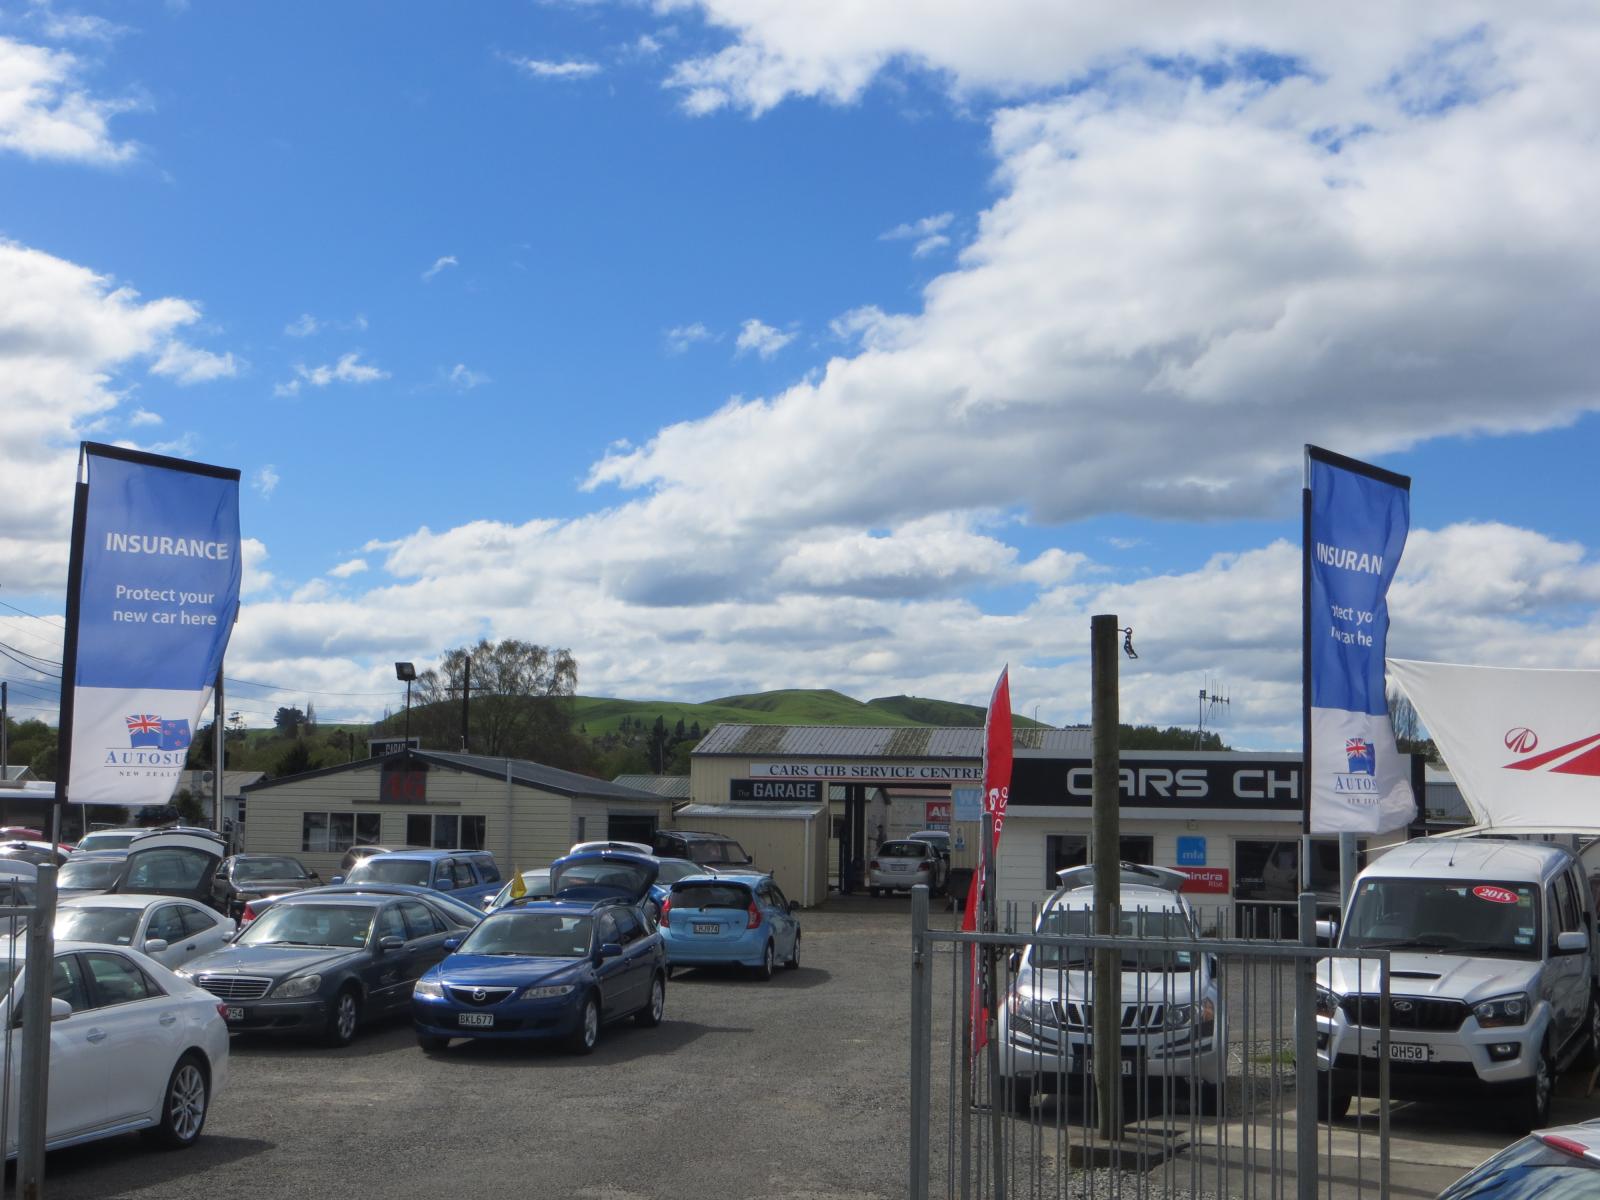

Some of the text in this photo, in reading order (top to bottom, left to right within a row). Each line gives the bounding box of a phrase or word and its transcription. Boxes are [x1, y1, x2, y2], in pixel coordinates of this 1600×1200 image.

[105, 532, 229, 560] INSURANCE
[115, 584, 215, 606] Protect your
[113, 610, 217, 625] new car here
[769, 764, 983, 779] CARS CHB SERVICE CENTRE
[753, 783, 816, 798] GARAGE
[1232, 769, 1299, 799] CH
[1479, 887, 1511, 901] 2015
[1391, 1045, 1423, 1059] QH50
